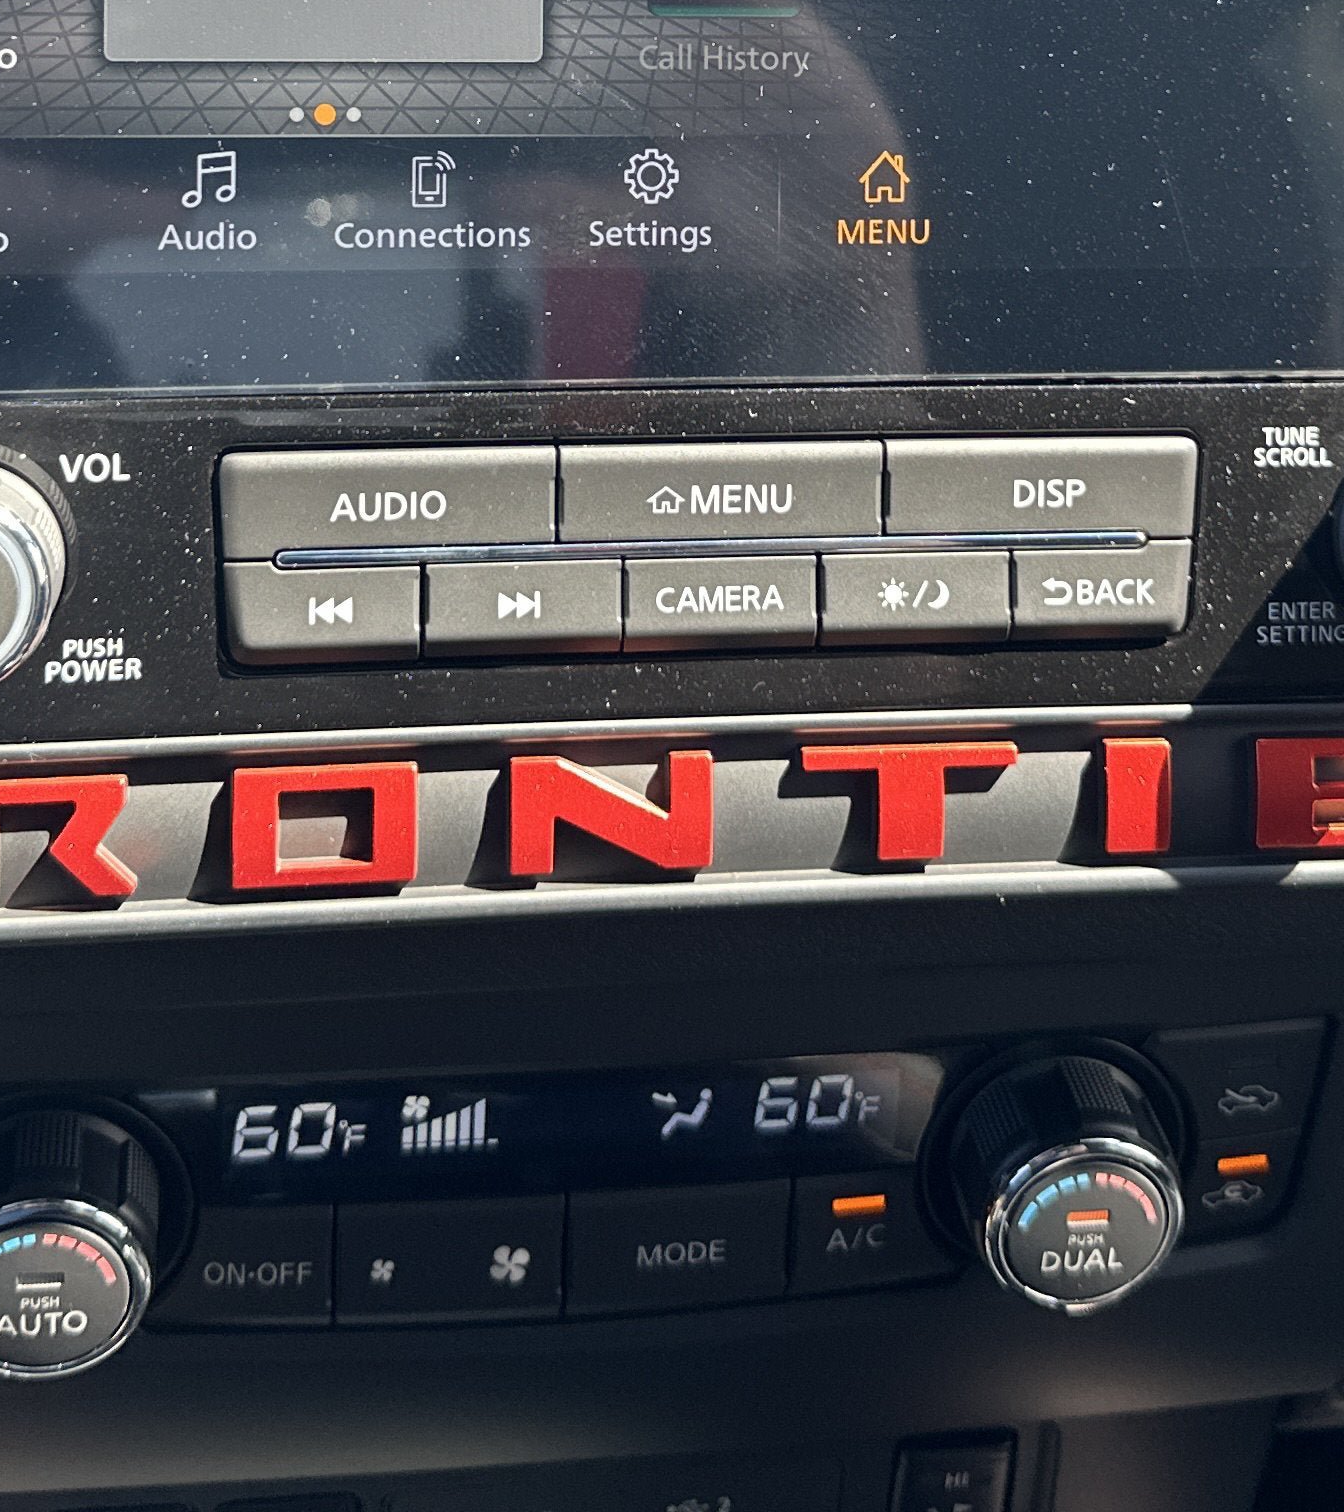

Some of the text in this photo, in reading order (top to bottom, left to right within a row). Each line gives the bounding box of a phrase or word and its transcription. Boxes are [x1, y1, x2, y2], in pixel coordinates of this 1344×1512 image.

[639, 44, 810, 76] Call History
[158, 223, 257, 252] Audio
[333, 222, 532, 250] Connections
[588, 220, 713, 252] Settings
[837, 218, 931, 246] MENU
[1262, 426, 1320, 448] TUNE
[59, 453, 131, 484] VOL
[1254, 447, 1333, 469] SCROLL
[329, 490, 448, 522] AUDIO
[690, 484, 794, 515] MENU
[1012, 478, 1087, 509] DISP
[655, 584, 784, 614] CAMERA
[1075, 578, 1155, 606] BACK
[1267, 601, 1336, 622] ENTER
[62, 638, 123, 659] PUSH
[45, 657, 143, 685] POWER
[826, 1224, 887, 1253] A/C
[1068, 1233, 1104, 1247] PUSH
[637, 1239, 726, 1269] MODE
[1040, 1247, 1124, 1275] DUAL
[20, 1296, 60, 1311] PUSH
